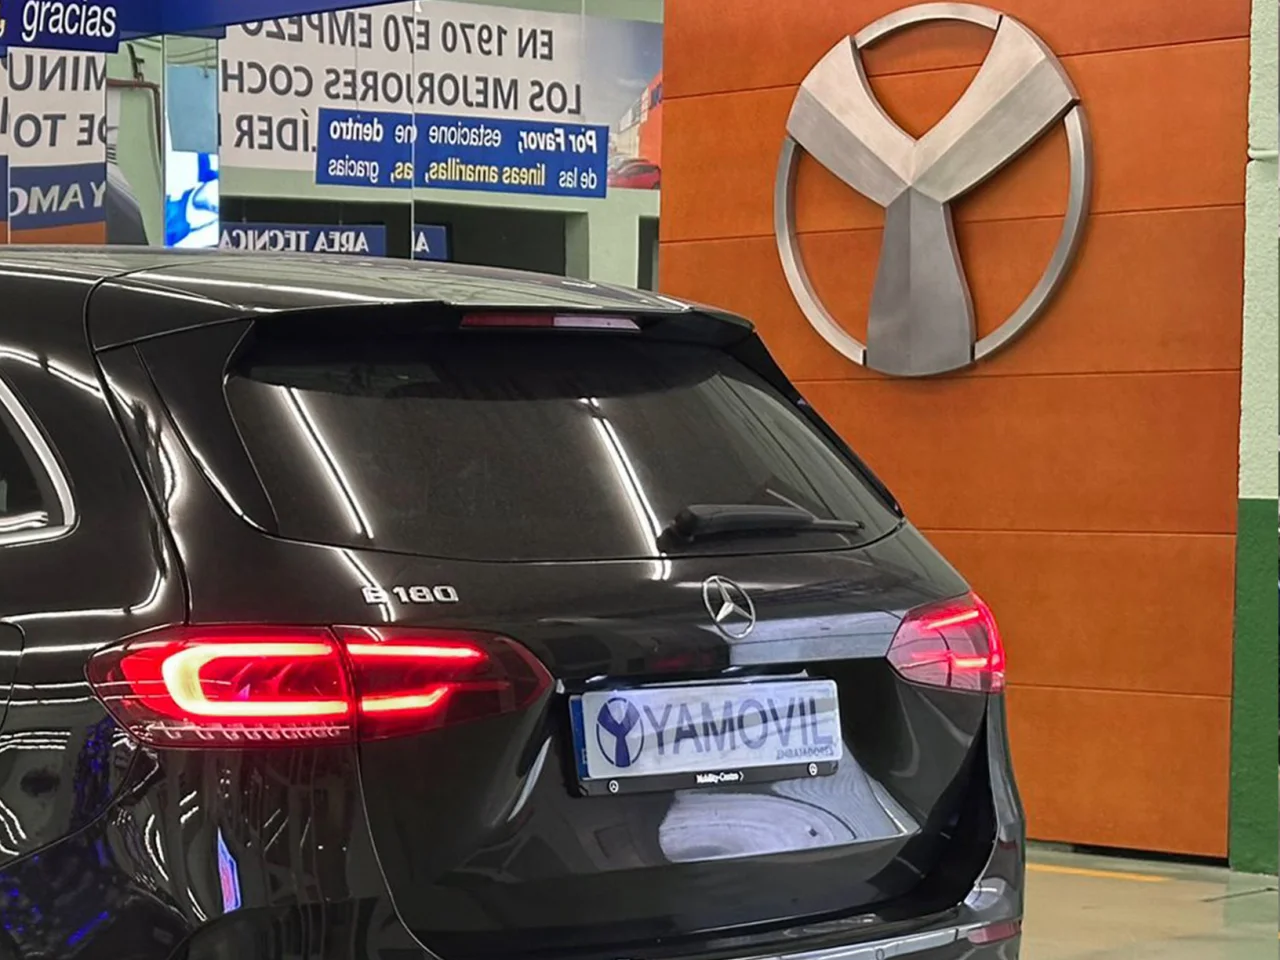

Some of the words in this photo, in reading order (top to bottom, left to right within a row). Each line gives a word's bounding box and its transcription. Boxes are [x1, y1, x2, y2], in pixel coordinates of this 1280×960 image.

[20, 0, 116, 42] gracias
[392, 585, 460, 603] 180
[643, 695, 834, 756] YAMOVIL
